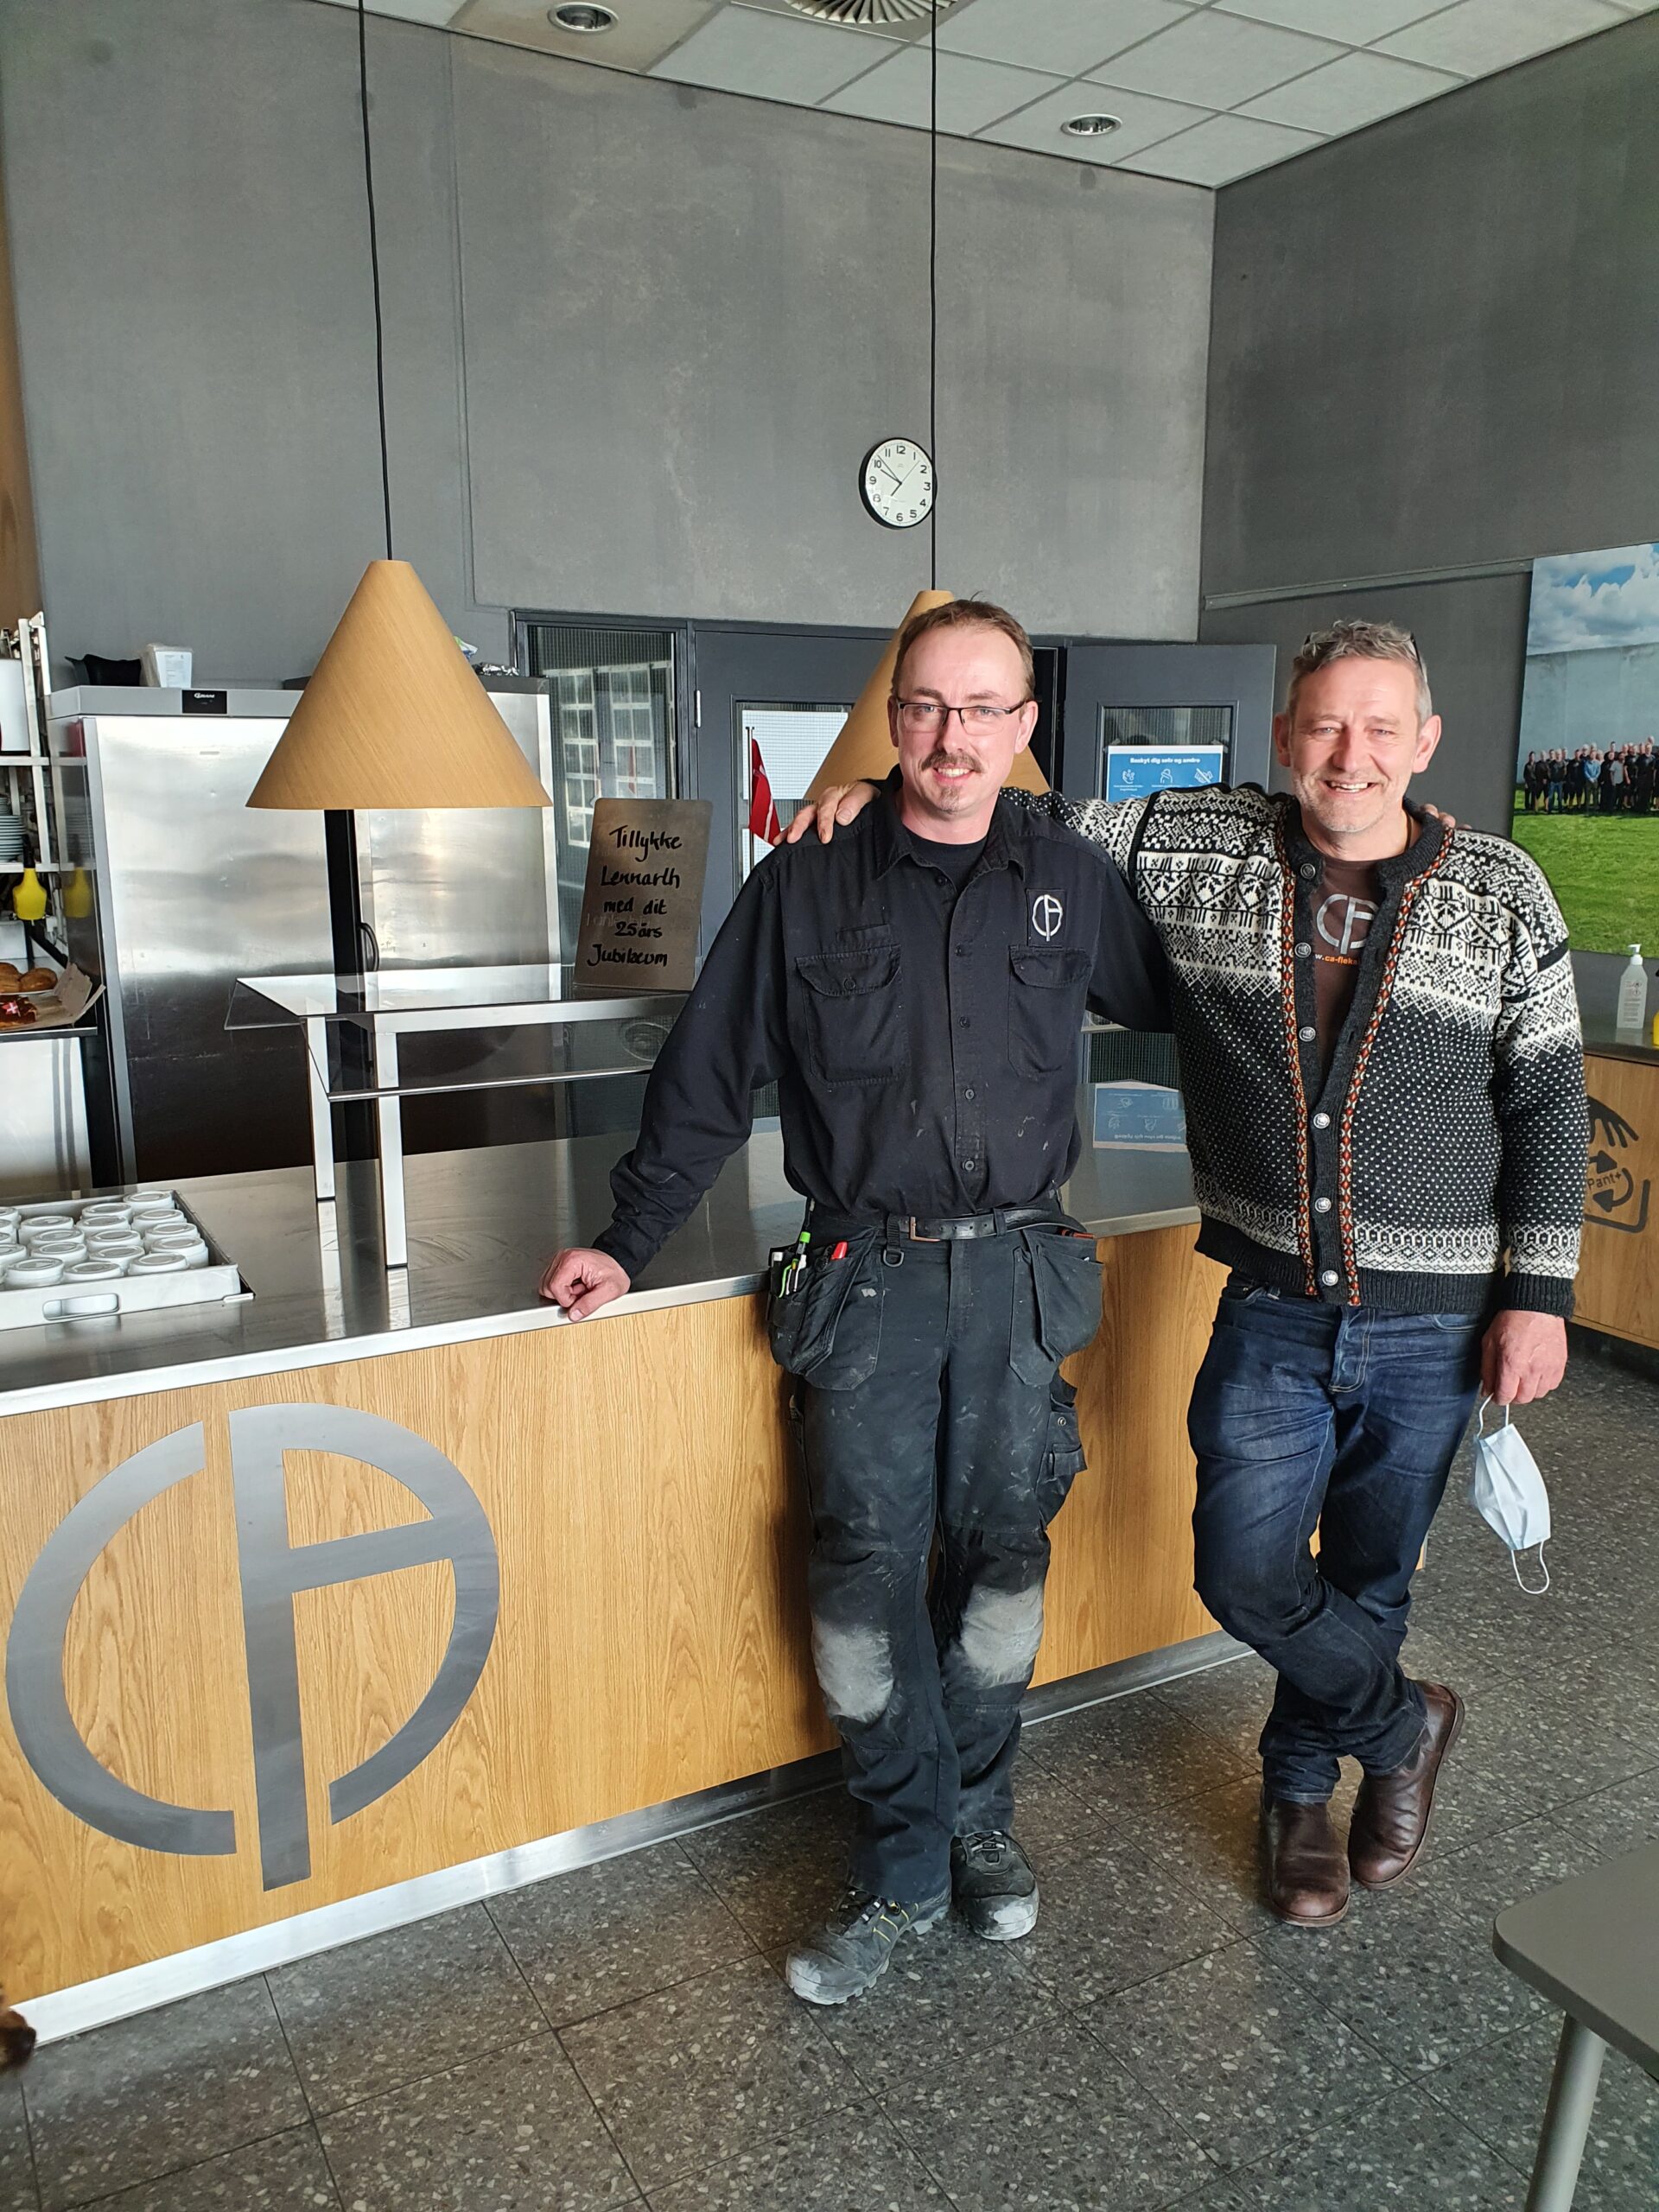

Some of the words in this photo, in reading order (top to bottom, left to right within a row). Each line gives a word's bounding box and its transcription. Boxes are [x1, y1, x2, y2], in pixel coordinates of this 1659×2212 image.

[885, 448, 891, 458] 11
[896, 445, 906, 454] 12
[912, 451, 916, 461] 1
[874, 460, 882, 469] 10
[919, 465, 927, 474] 2
[869, 476, 877, 485] 9
[923, 481, 931, 491] 3
[873, 493, 881, 503] 8
[919, 499, 926, 507] 4
[883, 506, 890, 516] 7
[910, 510, 918, 518] 5
[896, 512, 904, 522] 6
[608, 824, 683, 862] Tillykke
[601, 866, 680, 888] Lennarth
[603, 897, 634, 913] med
[642, 899, 667, 915] dit
